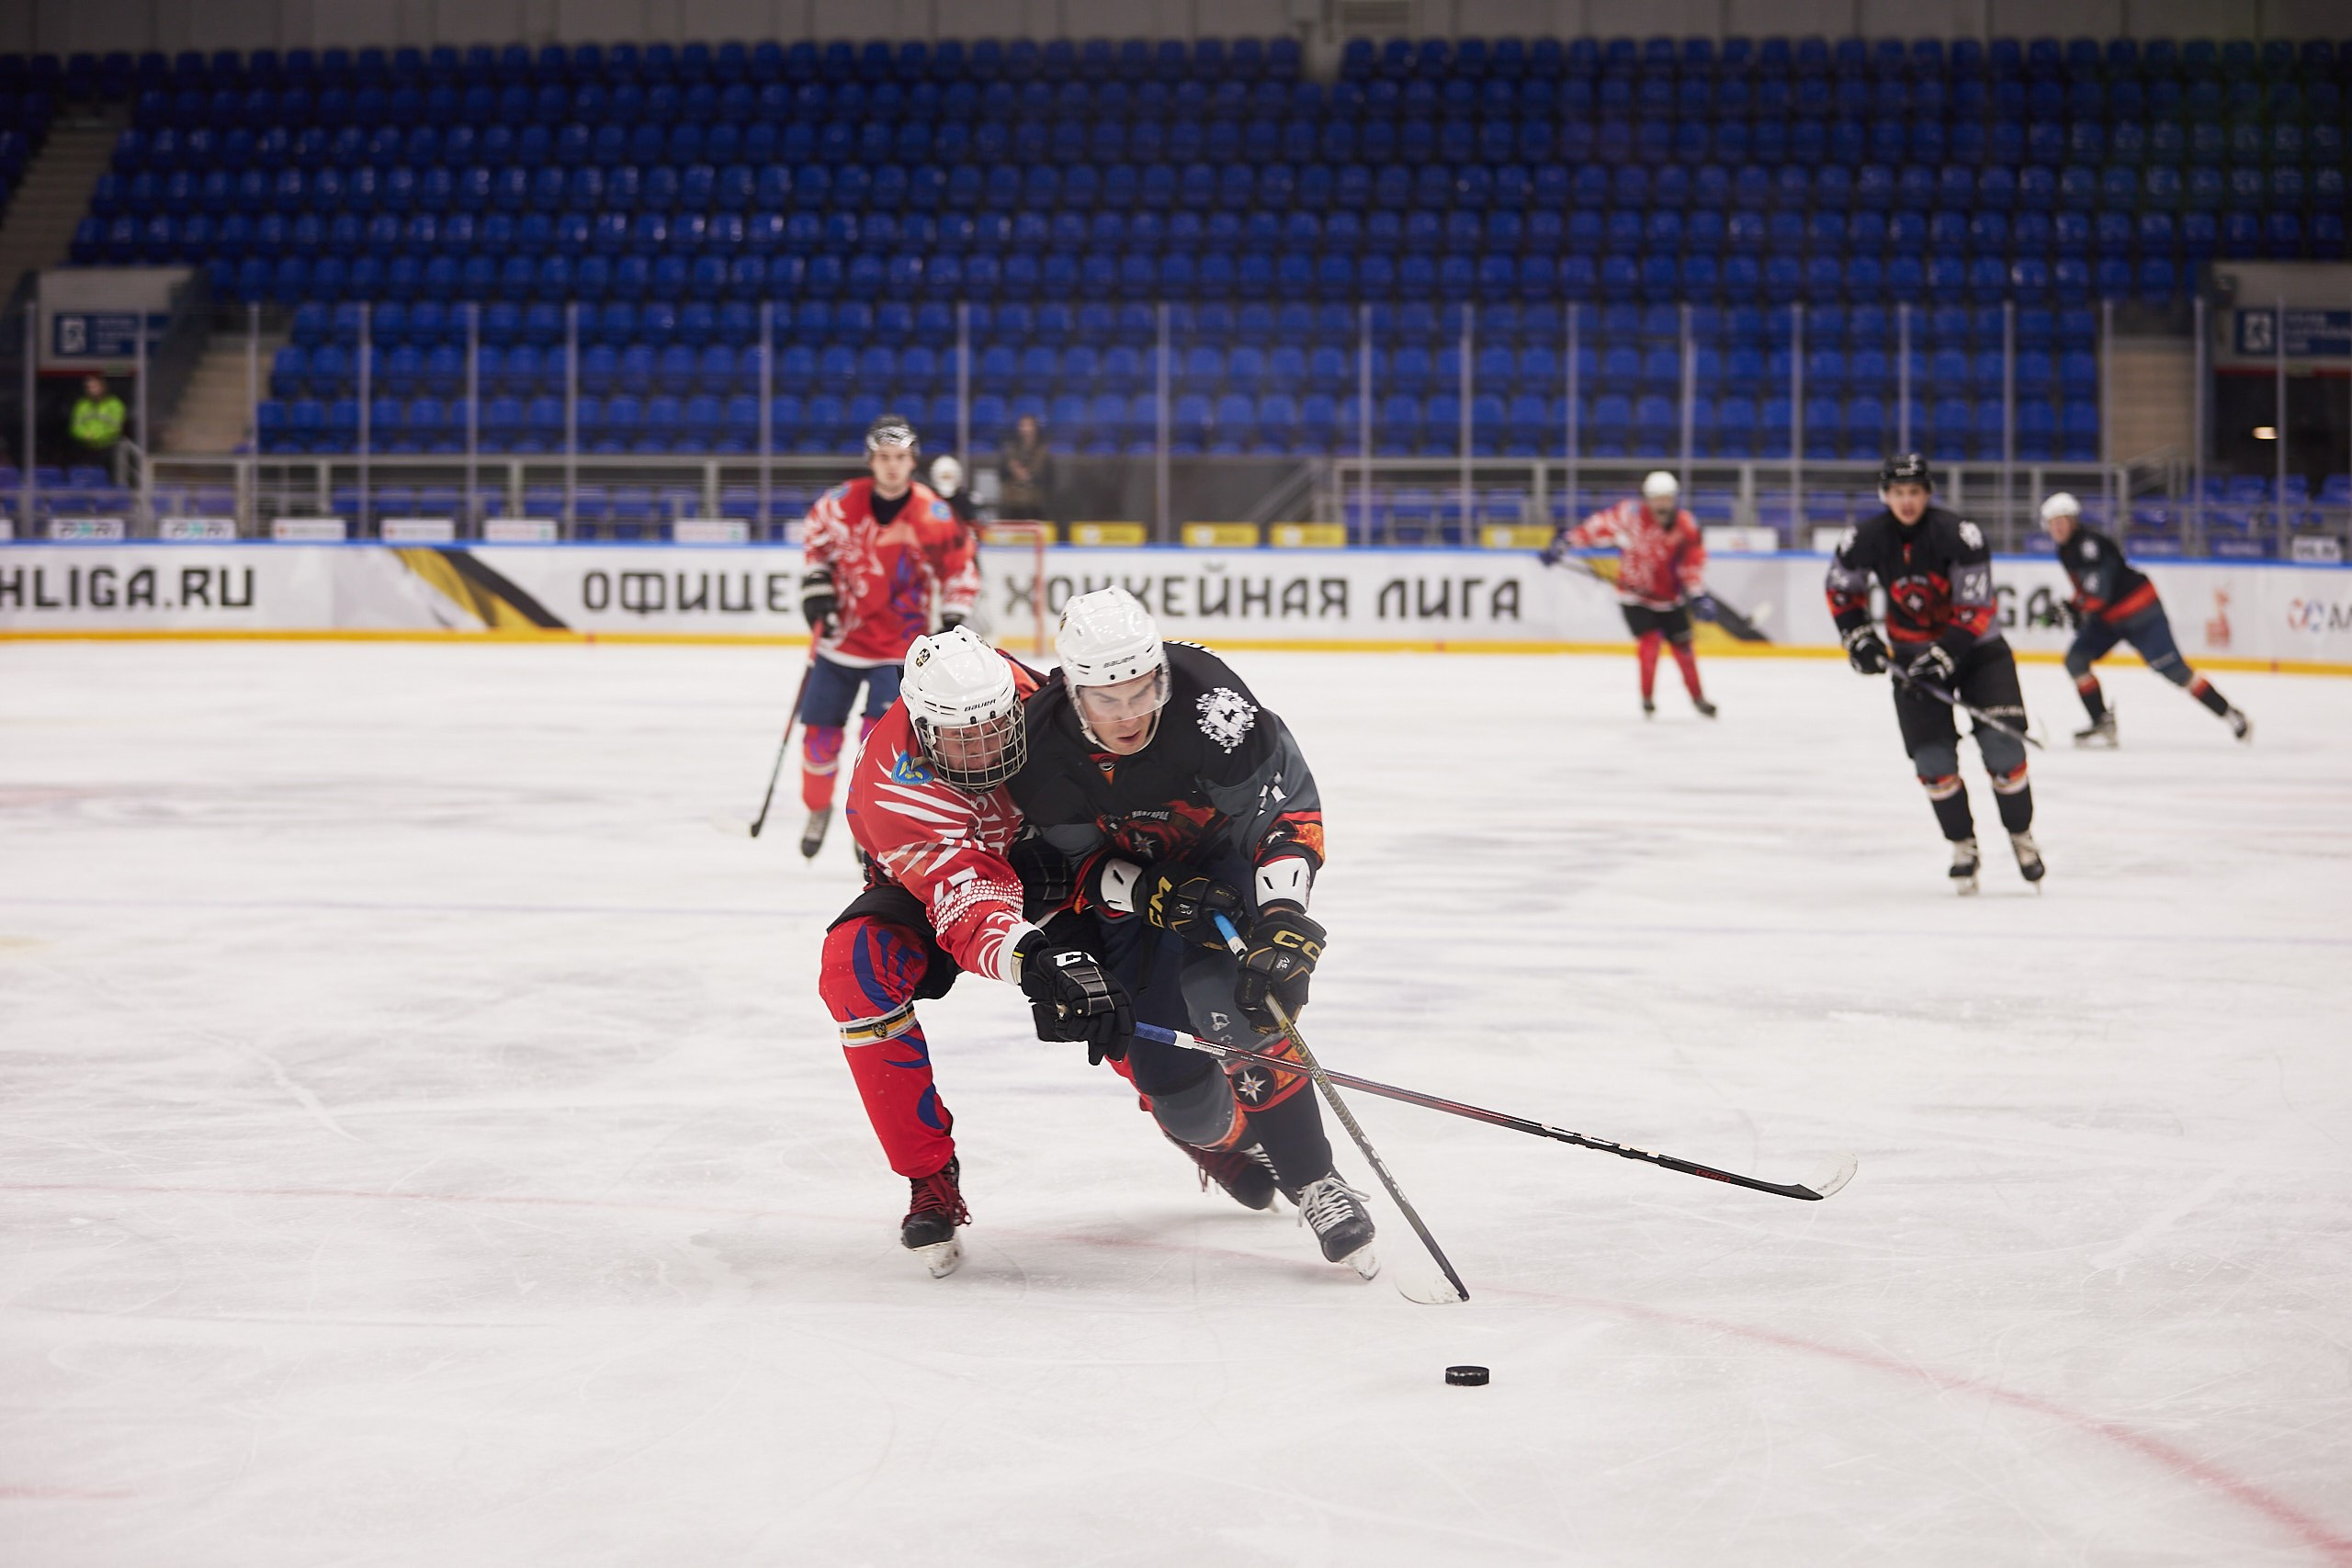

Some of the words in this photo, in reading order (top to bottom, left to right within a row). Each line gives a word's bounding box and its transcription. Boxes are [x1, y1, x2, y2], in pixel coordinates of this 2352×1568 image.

[1378, 577, 1521, 619] ЛИГА
[1962, 570, 1990, 603] 24
[964, 698, 996, 712] BAUER
[1283, 1021, 1306, 1055] TACKS
